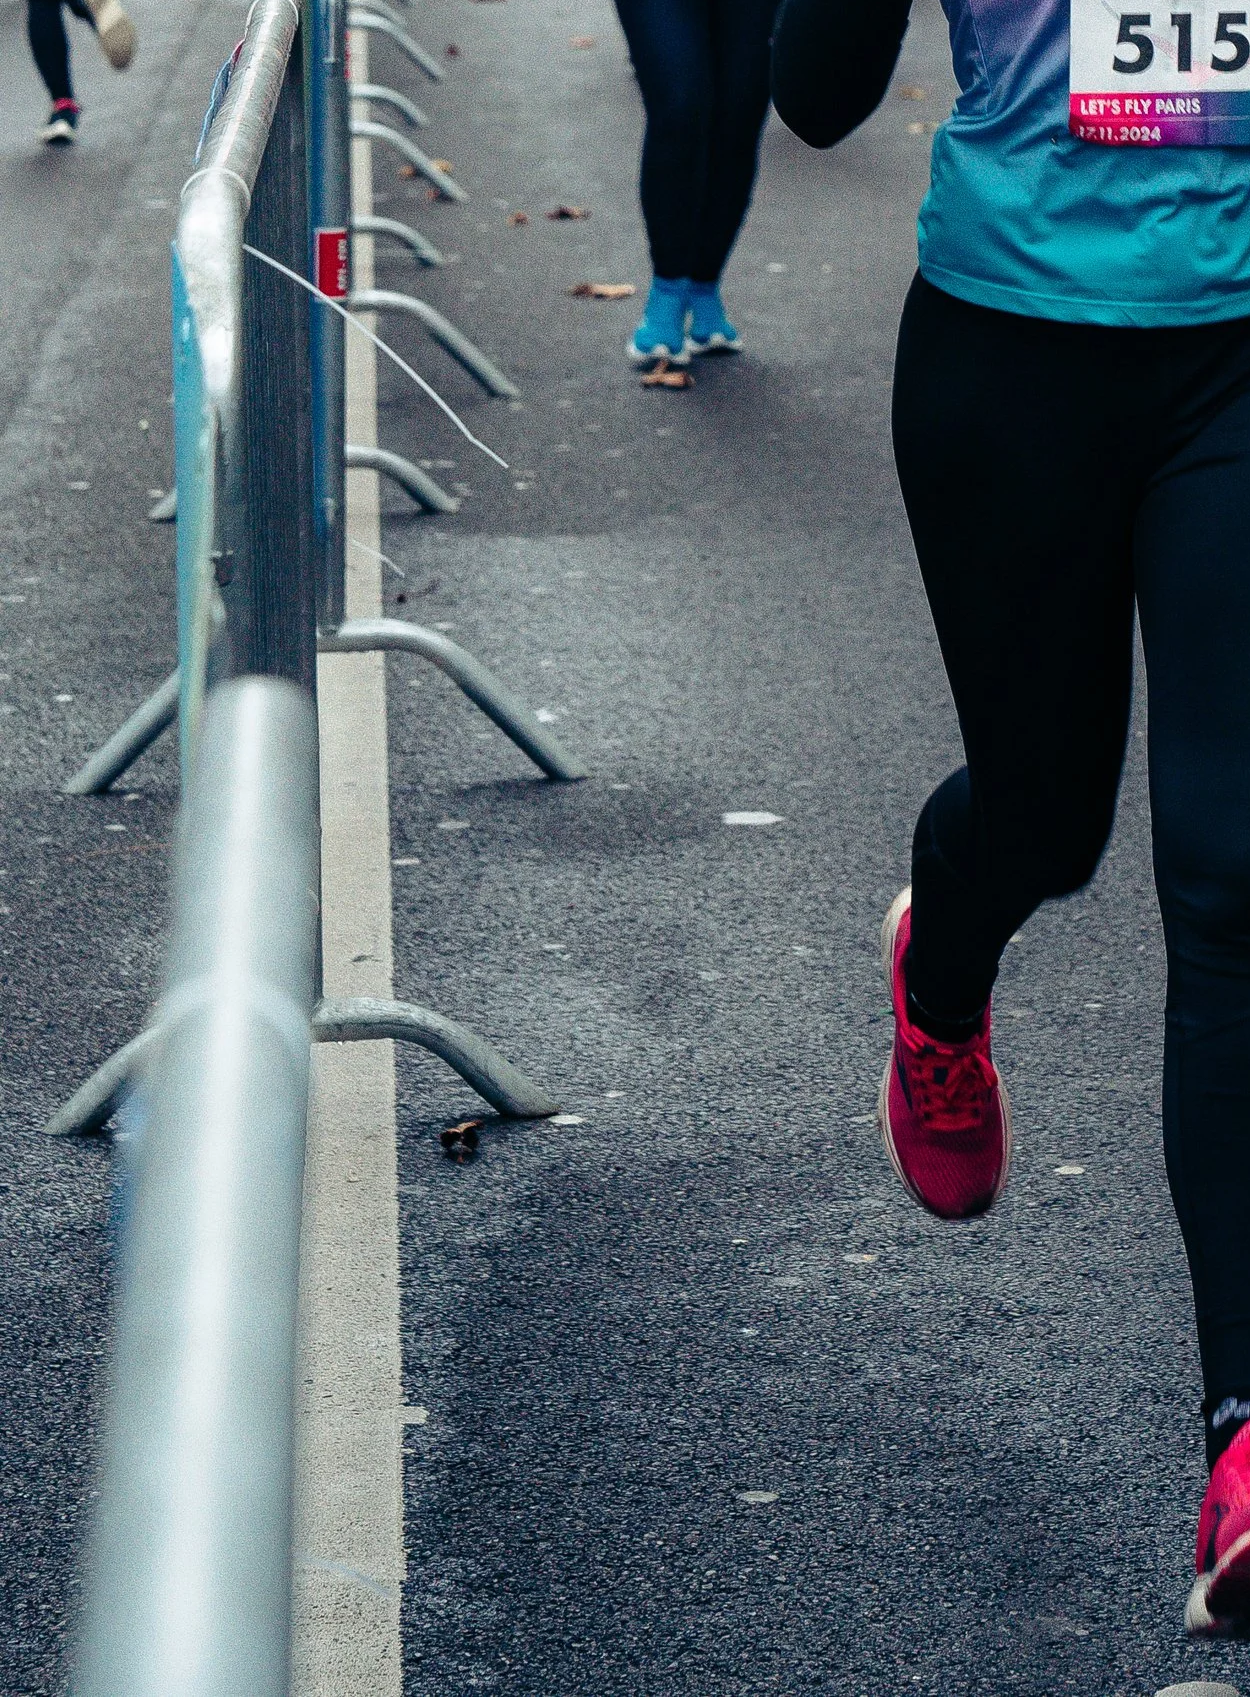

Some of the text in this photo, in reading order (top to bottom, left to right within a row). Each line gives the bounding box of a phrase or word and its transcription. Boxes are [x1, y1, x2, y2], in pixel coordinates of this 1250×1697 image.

[1079, 98, 1201, 116] LET'S FLY PARIS
